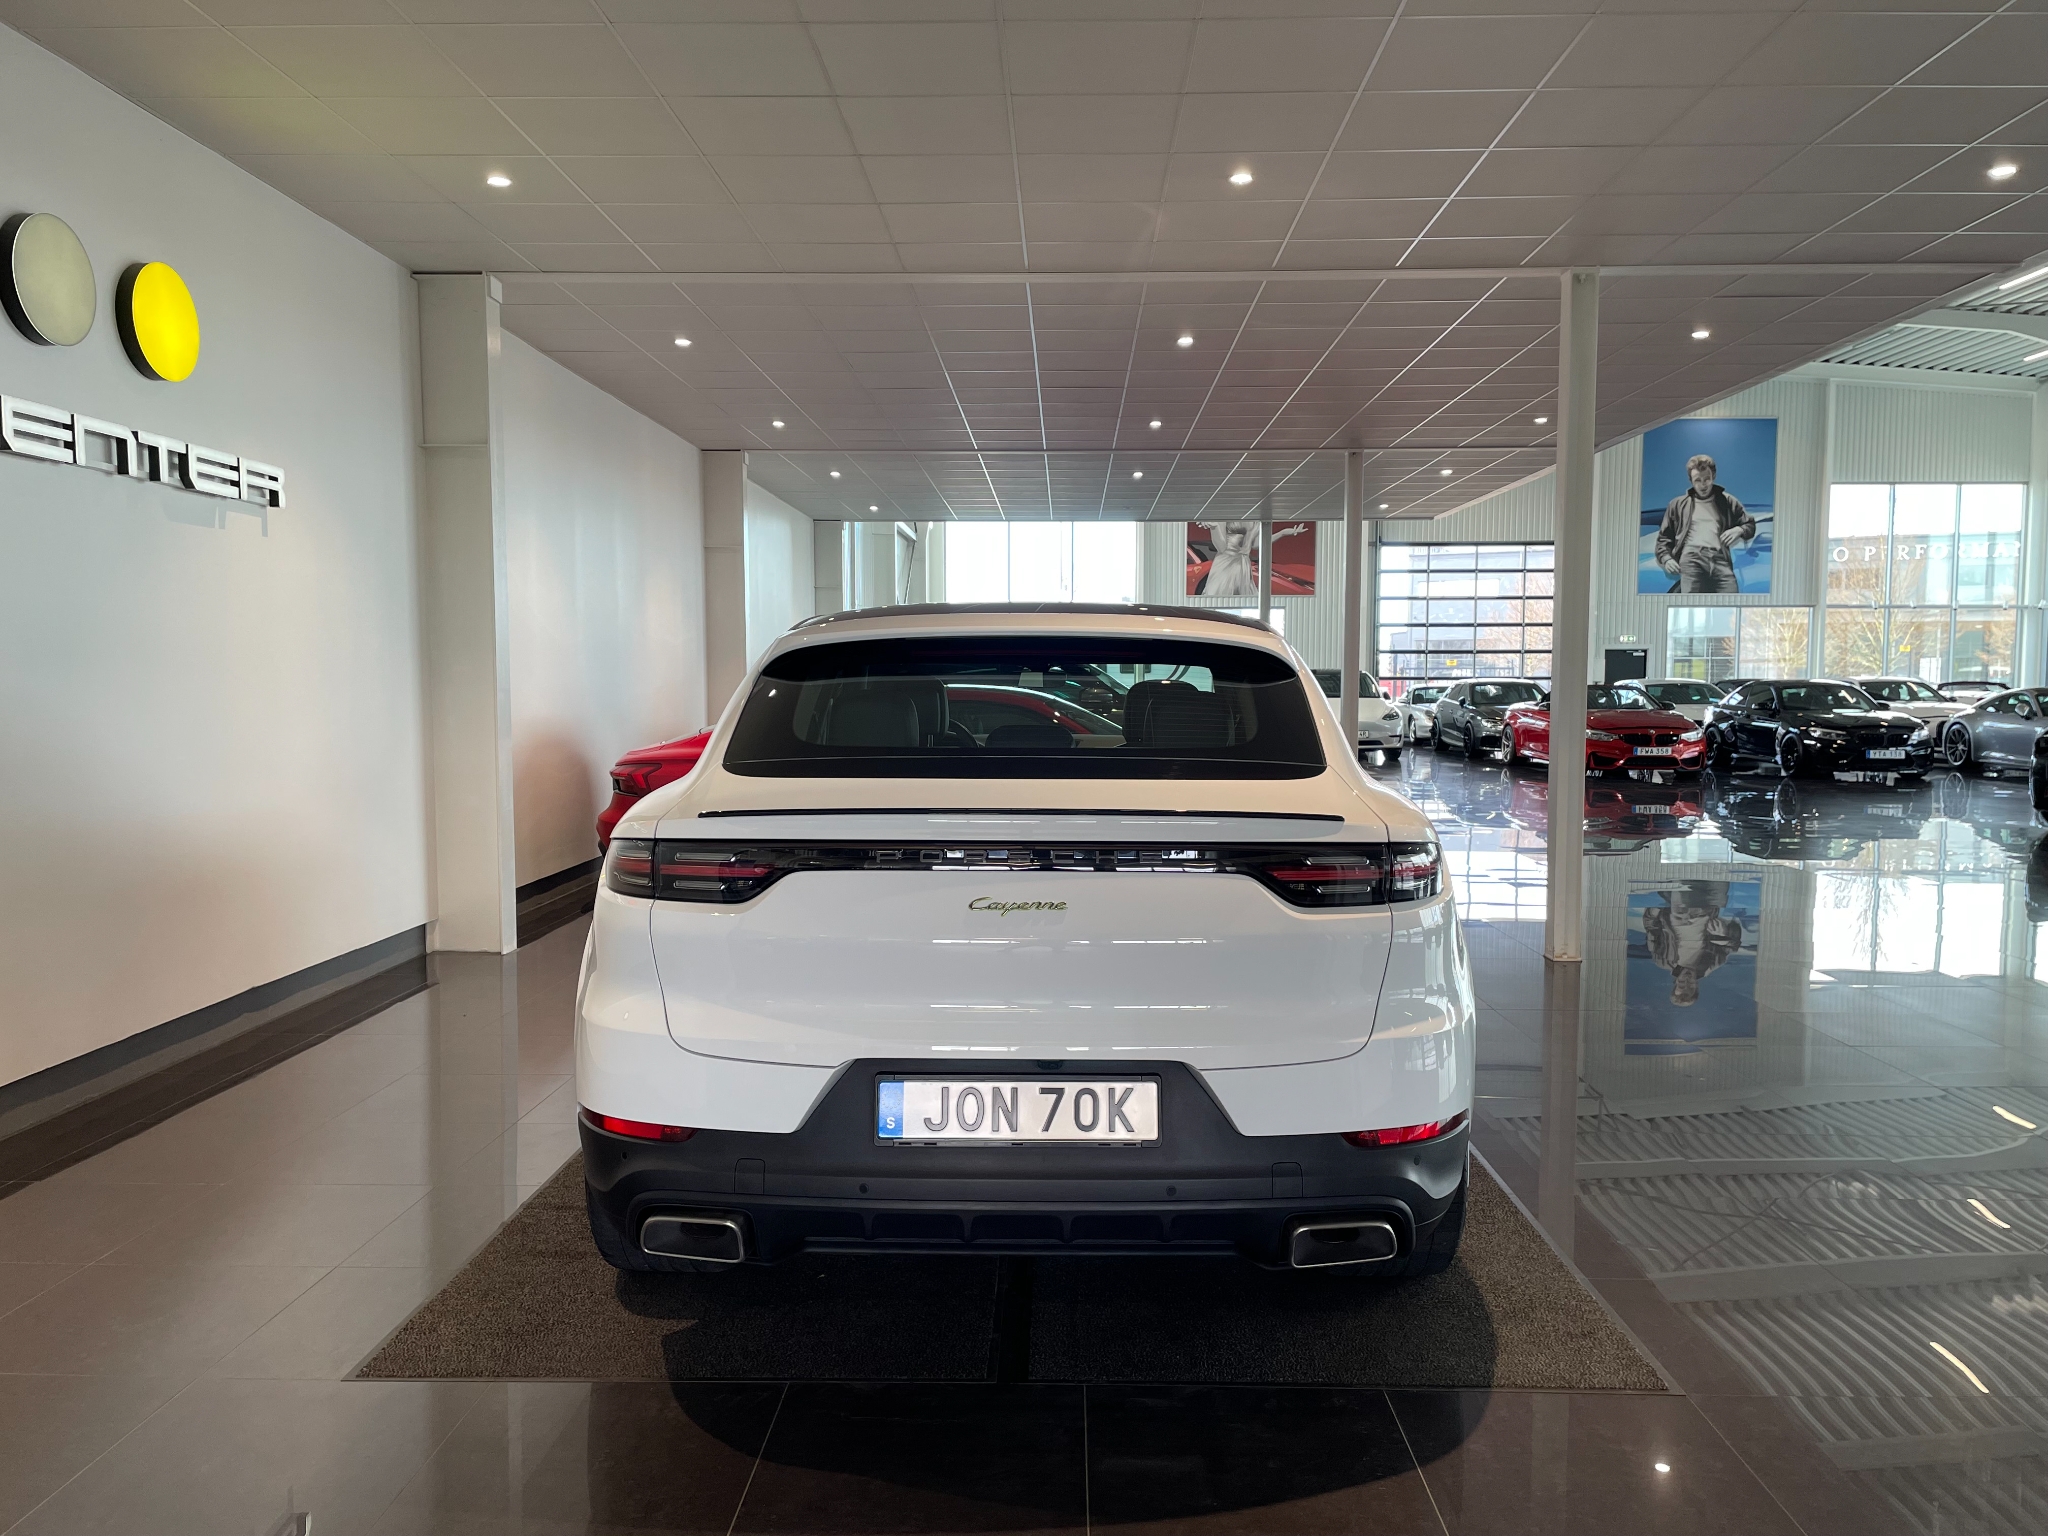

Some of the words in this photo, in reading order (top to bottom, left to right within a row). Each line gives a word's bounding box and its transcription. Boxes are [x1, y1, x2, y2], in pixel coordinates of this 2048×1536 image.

[875, 849, 1163, 864] PORSCHE
[967, 896, 1069, 918] Cayenne
[886, 1117, 896, 1129] S
[923, 1086, 1019, 1133] JON
[1039, 1086, 1135, 1133] 70K
